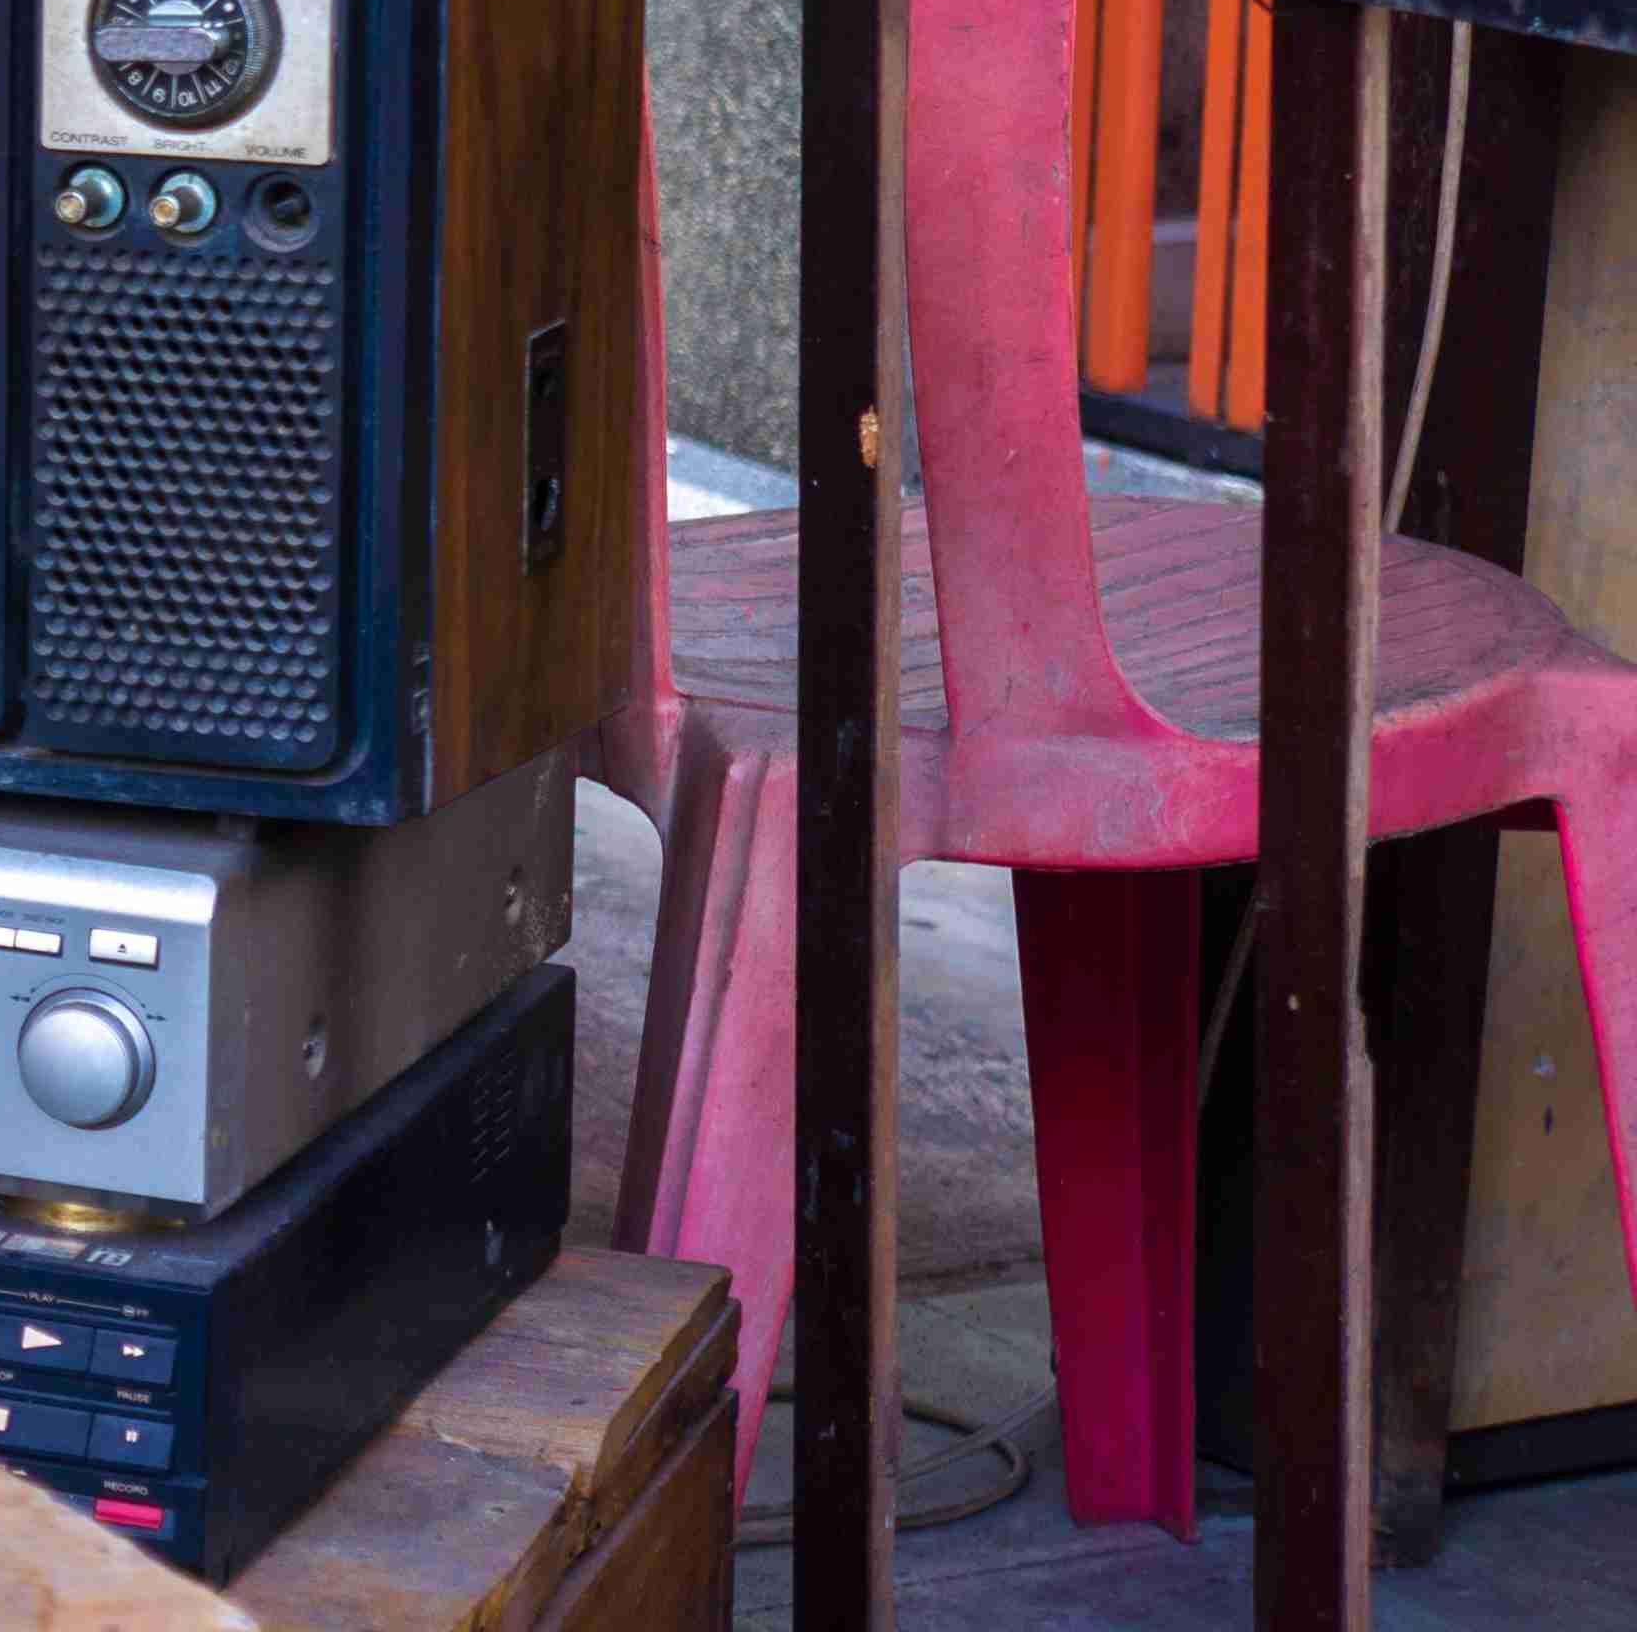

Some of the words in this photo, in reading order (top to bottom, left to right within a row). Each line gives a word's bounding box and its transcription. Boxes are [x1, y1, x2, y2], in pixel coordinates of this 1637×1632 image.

[177, 86, 200, 107] 10
[50, 130, 129, 147] CONTRAST
[244, 143, 307, 159] VOLUME
[28, 1291, 56, 1306] PLAY
[116, 1389, 151, 1405] PAUSE
[103, 1479, 150, 1497] RECORD
